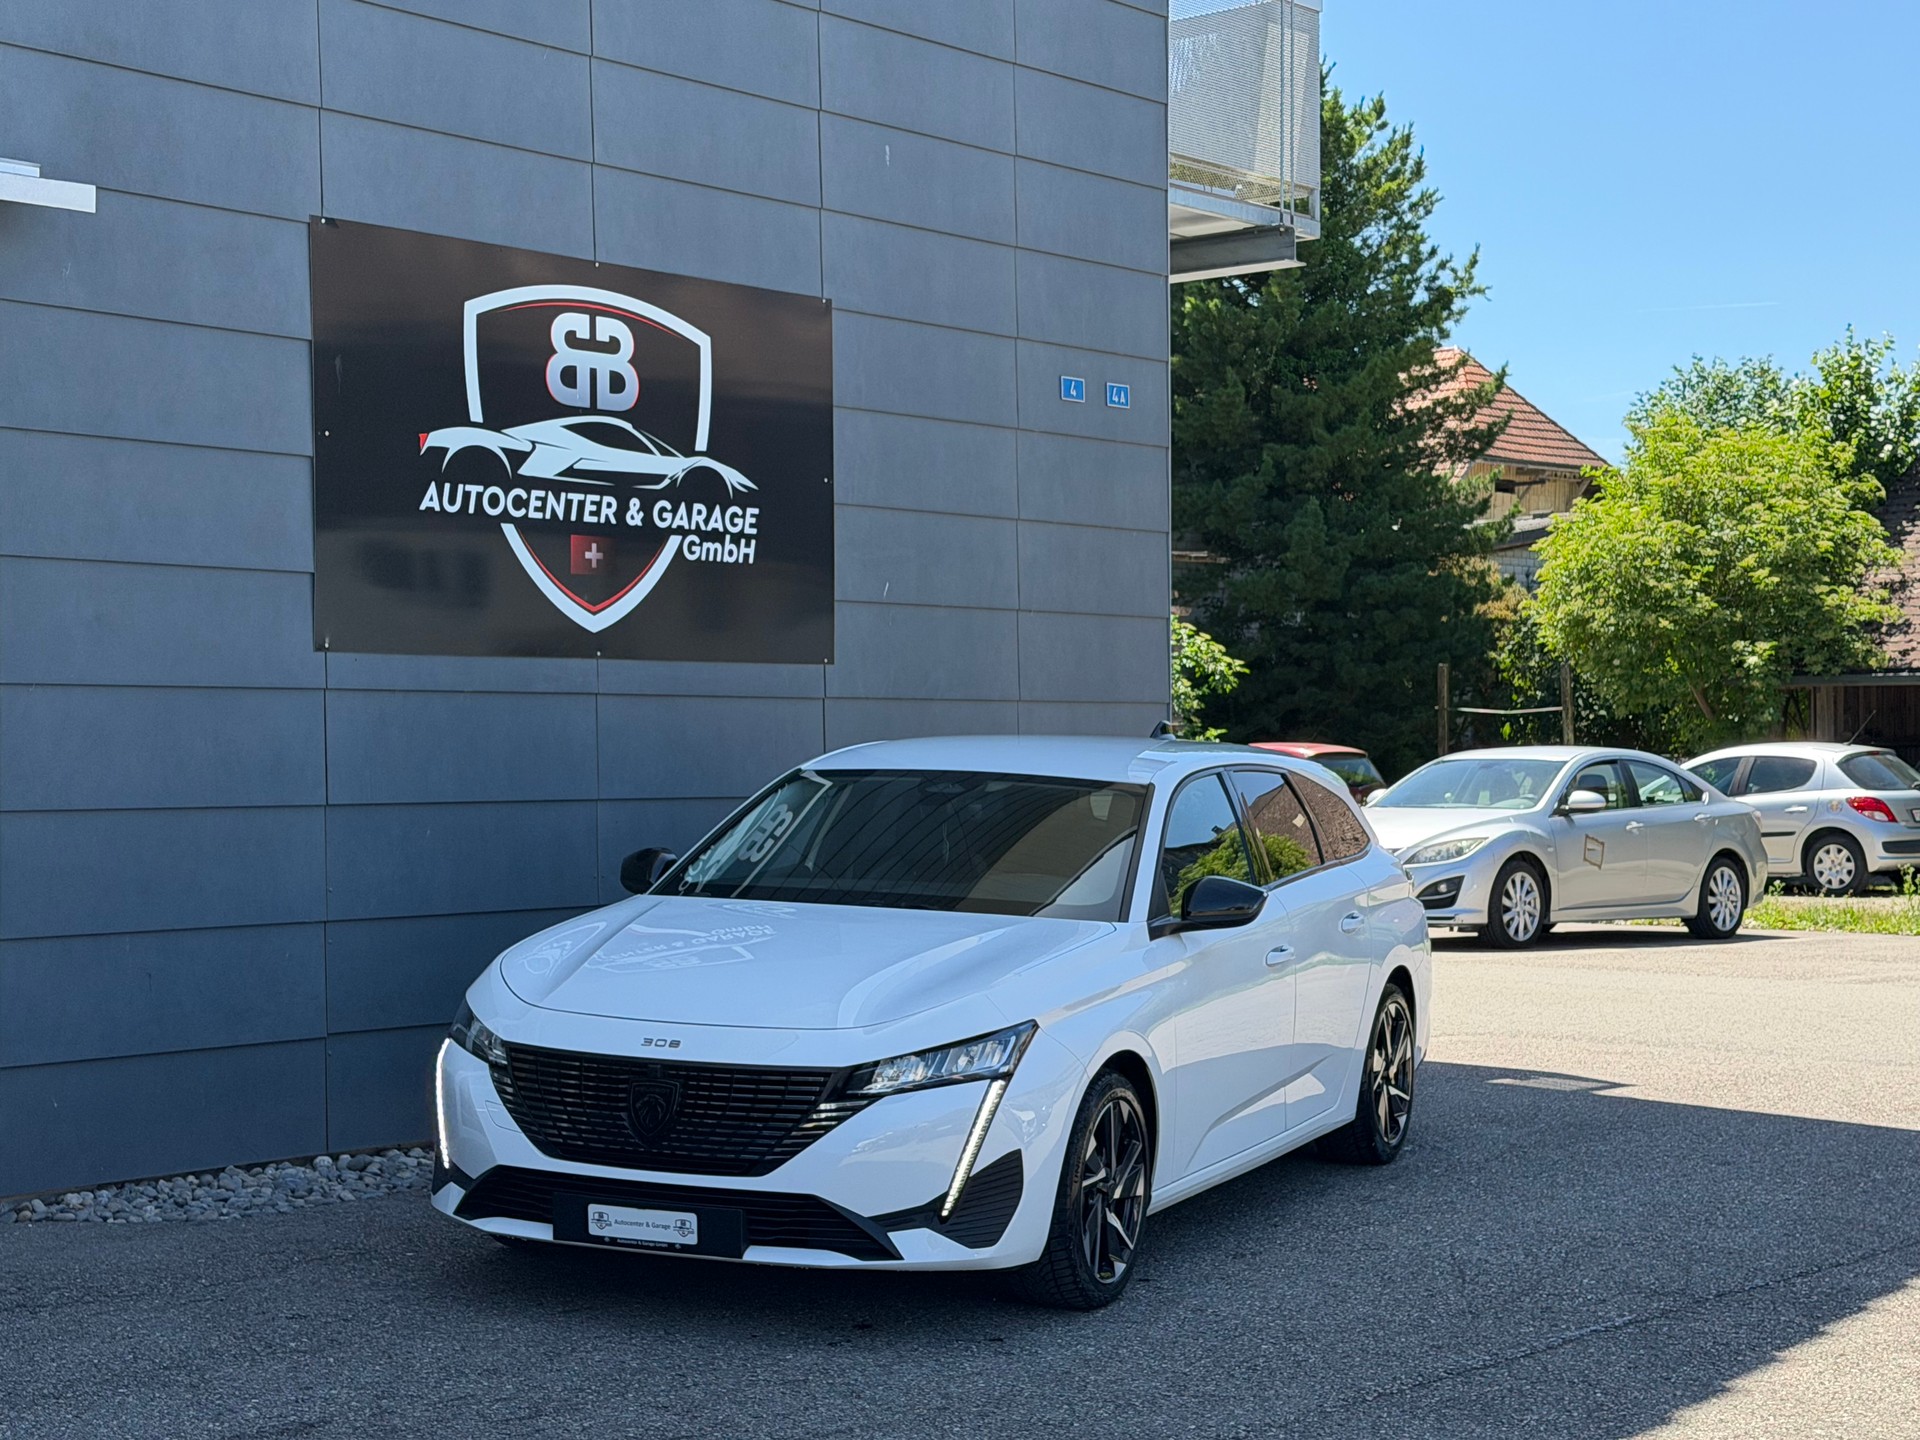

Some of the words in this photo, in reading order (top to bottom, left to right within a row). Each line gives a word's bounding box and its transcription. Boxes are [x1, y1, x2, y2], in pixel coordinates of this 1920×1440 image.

[1070, 381, 1077, 397] 4
[1112, 387, 1126, 404] 4A
[419, 480, 617, 525] AUTOCENTER
[625, 498, 645, 527] &
[652, 500, 760, 535] GARAGE
[682, 534, 757, 565] GmbH
[641, 1037, 681, 1048] 308
[651, 1222, 671, 1230] Garage
